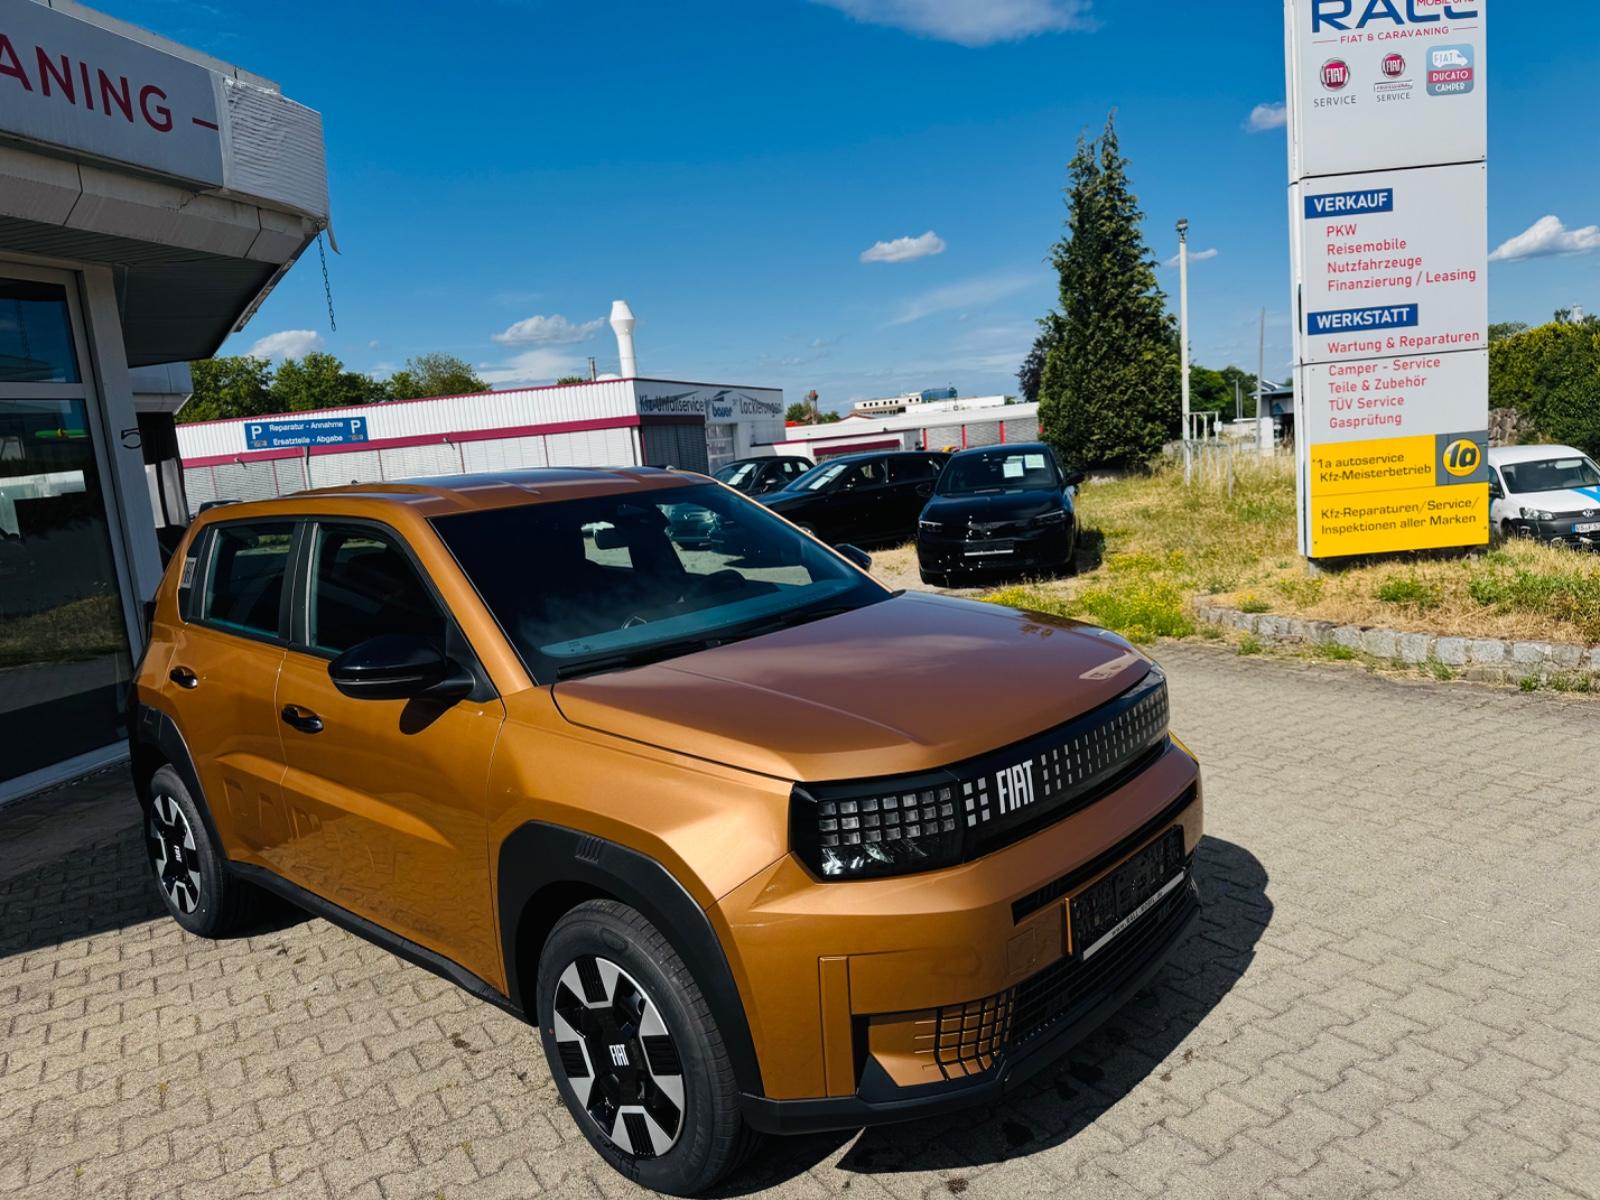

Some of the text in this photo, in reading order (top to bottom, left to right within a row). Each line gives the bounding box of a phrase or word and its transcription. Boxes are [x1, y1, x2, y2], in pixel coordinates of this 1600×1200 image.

[1340, 34, 1363, 44] FIAT
[1378, 26, 1450, 41] CARAVANING
[1434, 53, 1453, 62] FIAT
[1326, 67, 1344, 83] FIAT
[1432, 70, 1469, 81] DUCATO
[1435, 82, 1465, 92] CAMPER
[1313, 95, 1357, 108] SERVICE
[1376, 92, 1411, 103] SERVICE
[1313, 192, 1389, 212] VERKAUF
[1327, 224, 1357, 237] PKW
[1327, 238, 1407, 255] Reisemobile
[1327, 256, 1422, 274] Nutzfahrzeuge
[1328, 275, 1412, 292] Finanzierung
[1426, 269, 1476, 284] Leasing
[1317, 307, 1410, 329] WERKSTATT
[1328, 332, 1480, 354] Wartung & Reparaturen
[1328, 363, 1378, 377] Camper
[1392, 358, 1441, 372] Service
[1328, 376, 1427, 394] Teile & Zubehör
[1328, 394, 1405, 411] TÜV Service
[351, 420, 361, 433] P
[1329, 413, 1402, 429] Gasprüfung
[121, 428, 141, 449] 5
[251, 425, 262, 440] P
[1317, 453, 1405, 469] 1a autoservice
[1450, 443, 1477, 467] 1a
[1320, 465, 1431, 482] Kfz-Meisterbetrieb
[1321, 513, 1476, 535] Inspektionen aller Marken
[995, 759, 1035, 815] FIAT
[609, 1044, 630, 1067] FIAT
